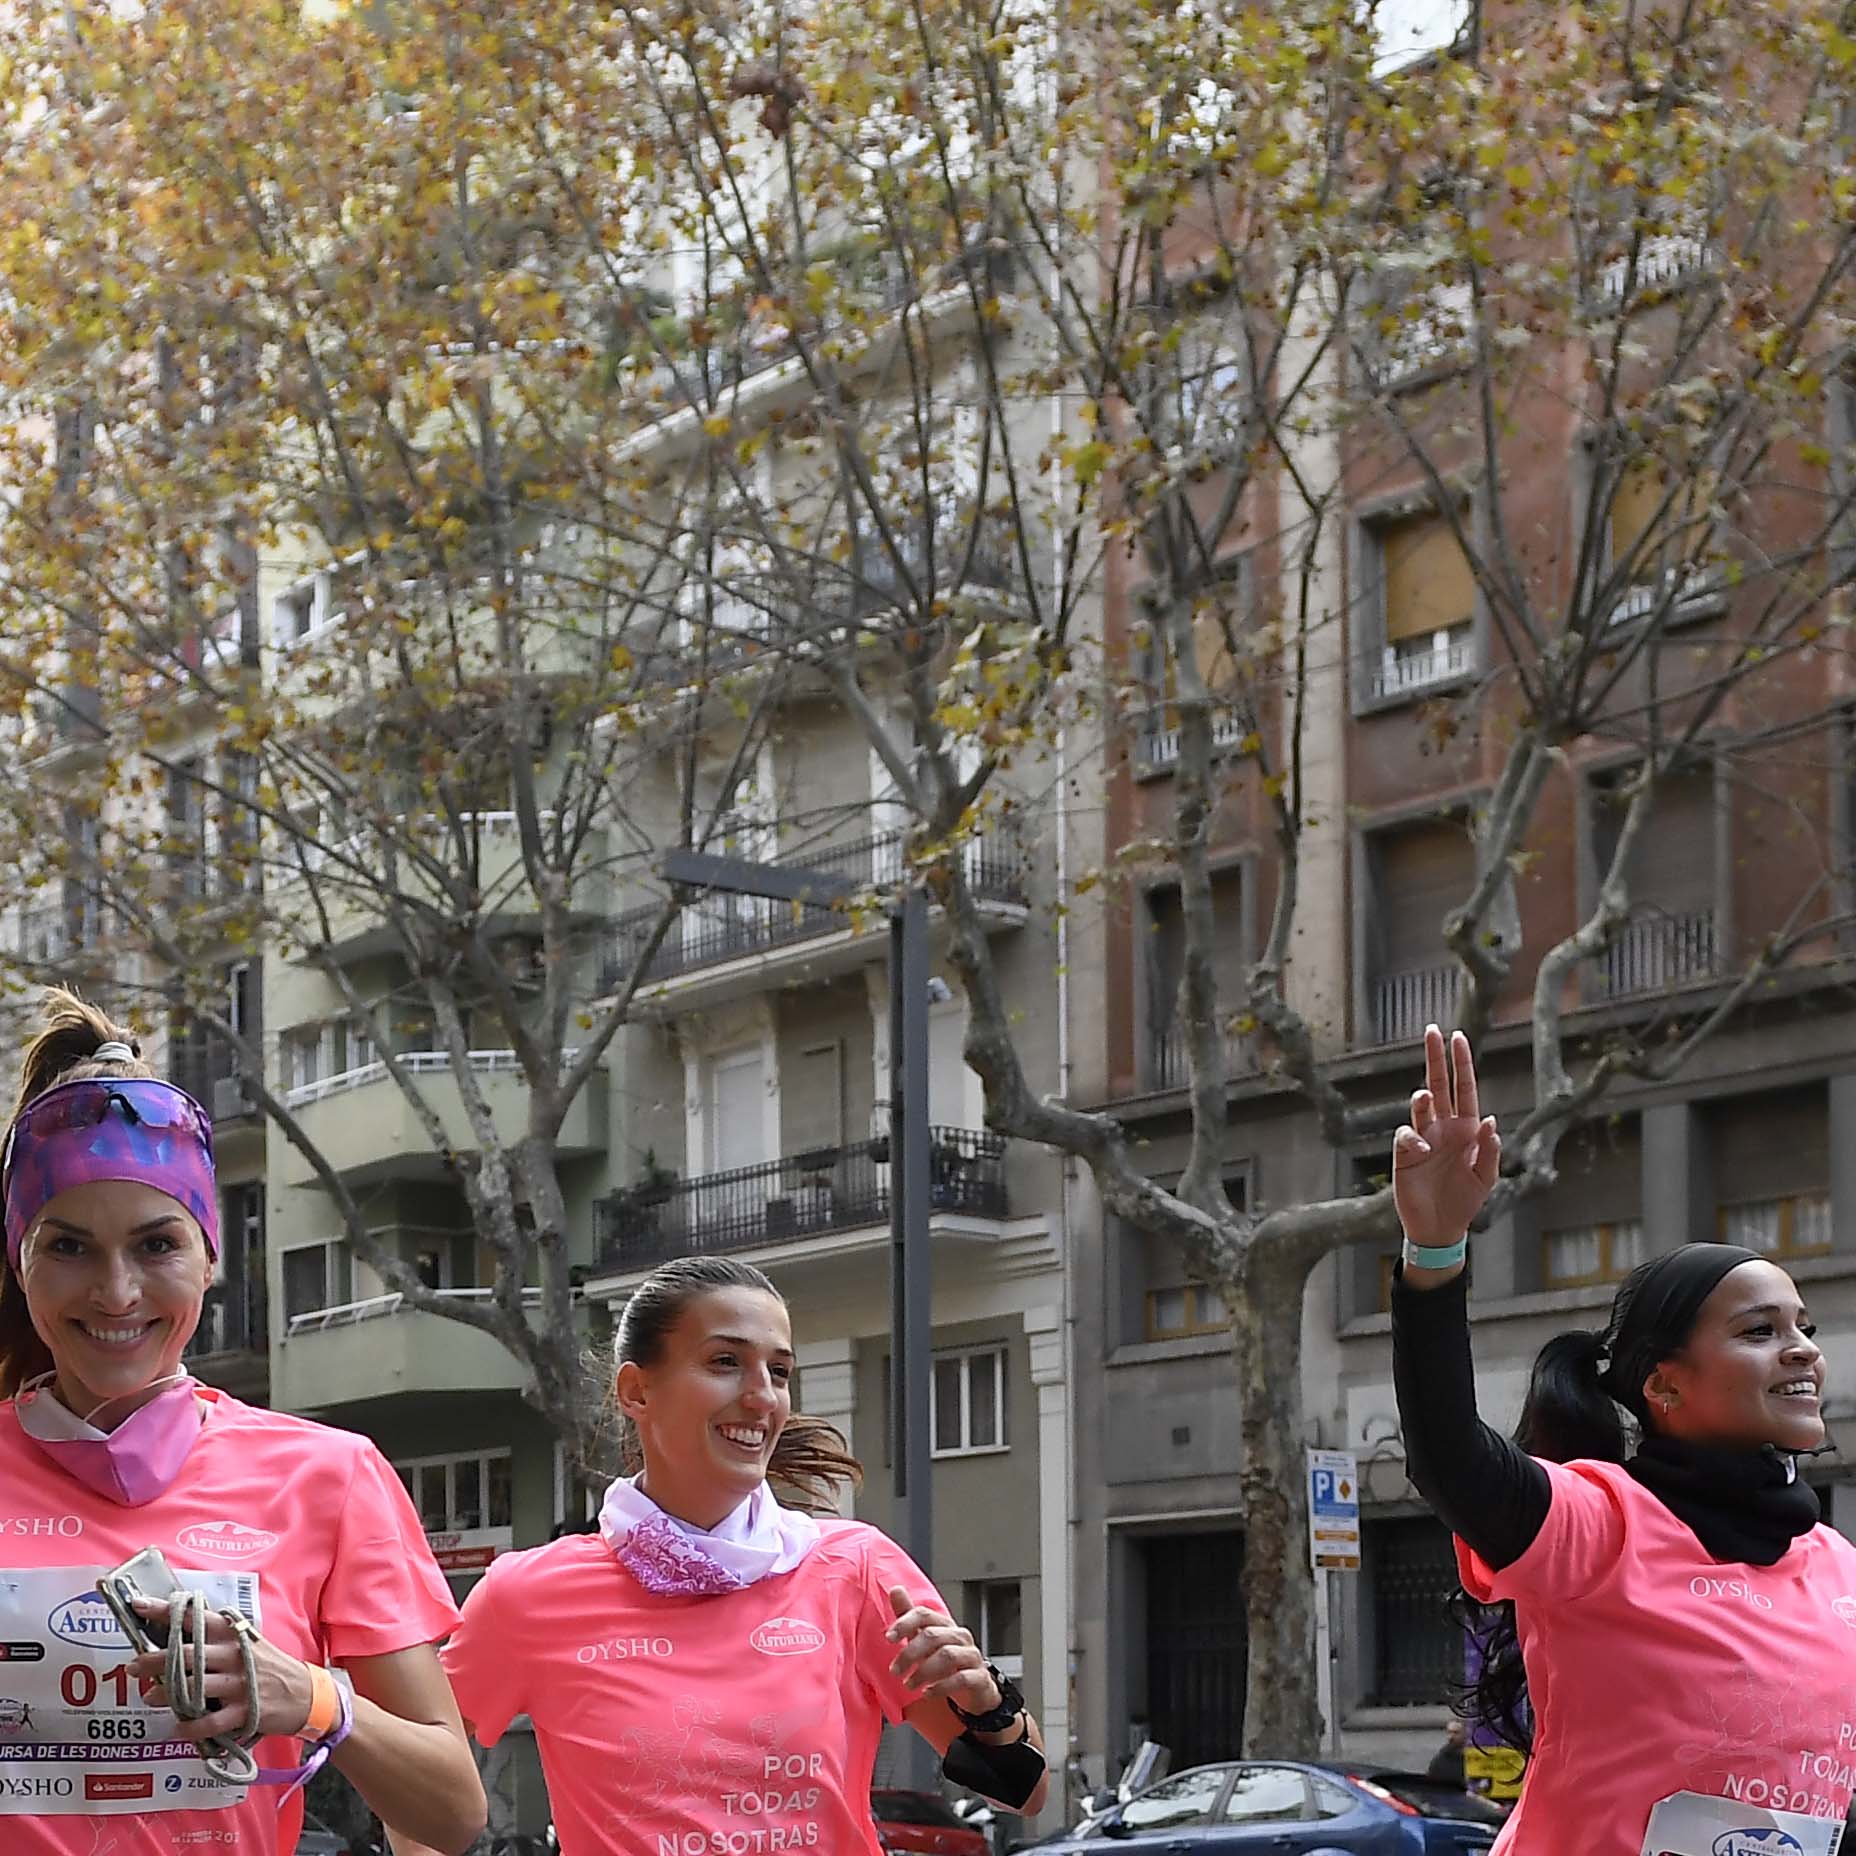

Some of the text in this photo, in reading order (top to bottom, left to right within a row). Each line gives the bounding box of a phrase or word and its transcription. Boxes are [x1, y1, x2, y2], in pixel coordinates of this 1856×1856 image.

[1690, 1576, 1772, 1609] OYSHO
[577, 1637, 673, 1664] OYSHO
[87, 1719, 146, 1740] 6863
[37, 1745, 57, 1759] DE
[60, 1744, 87, 1759] LES
[90, 1744, 140, 1758] DONES
[142, 1743, 164, 1758] DE
[764, 1753, 823, 1779] POR
[103, 1781, 146, 1793] Santander
[720, 1787, 821, 1817] TODAS
